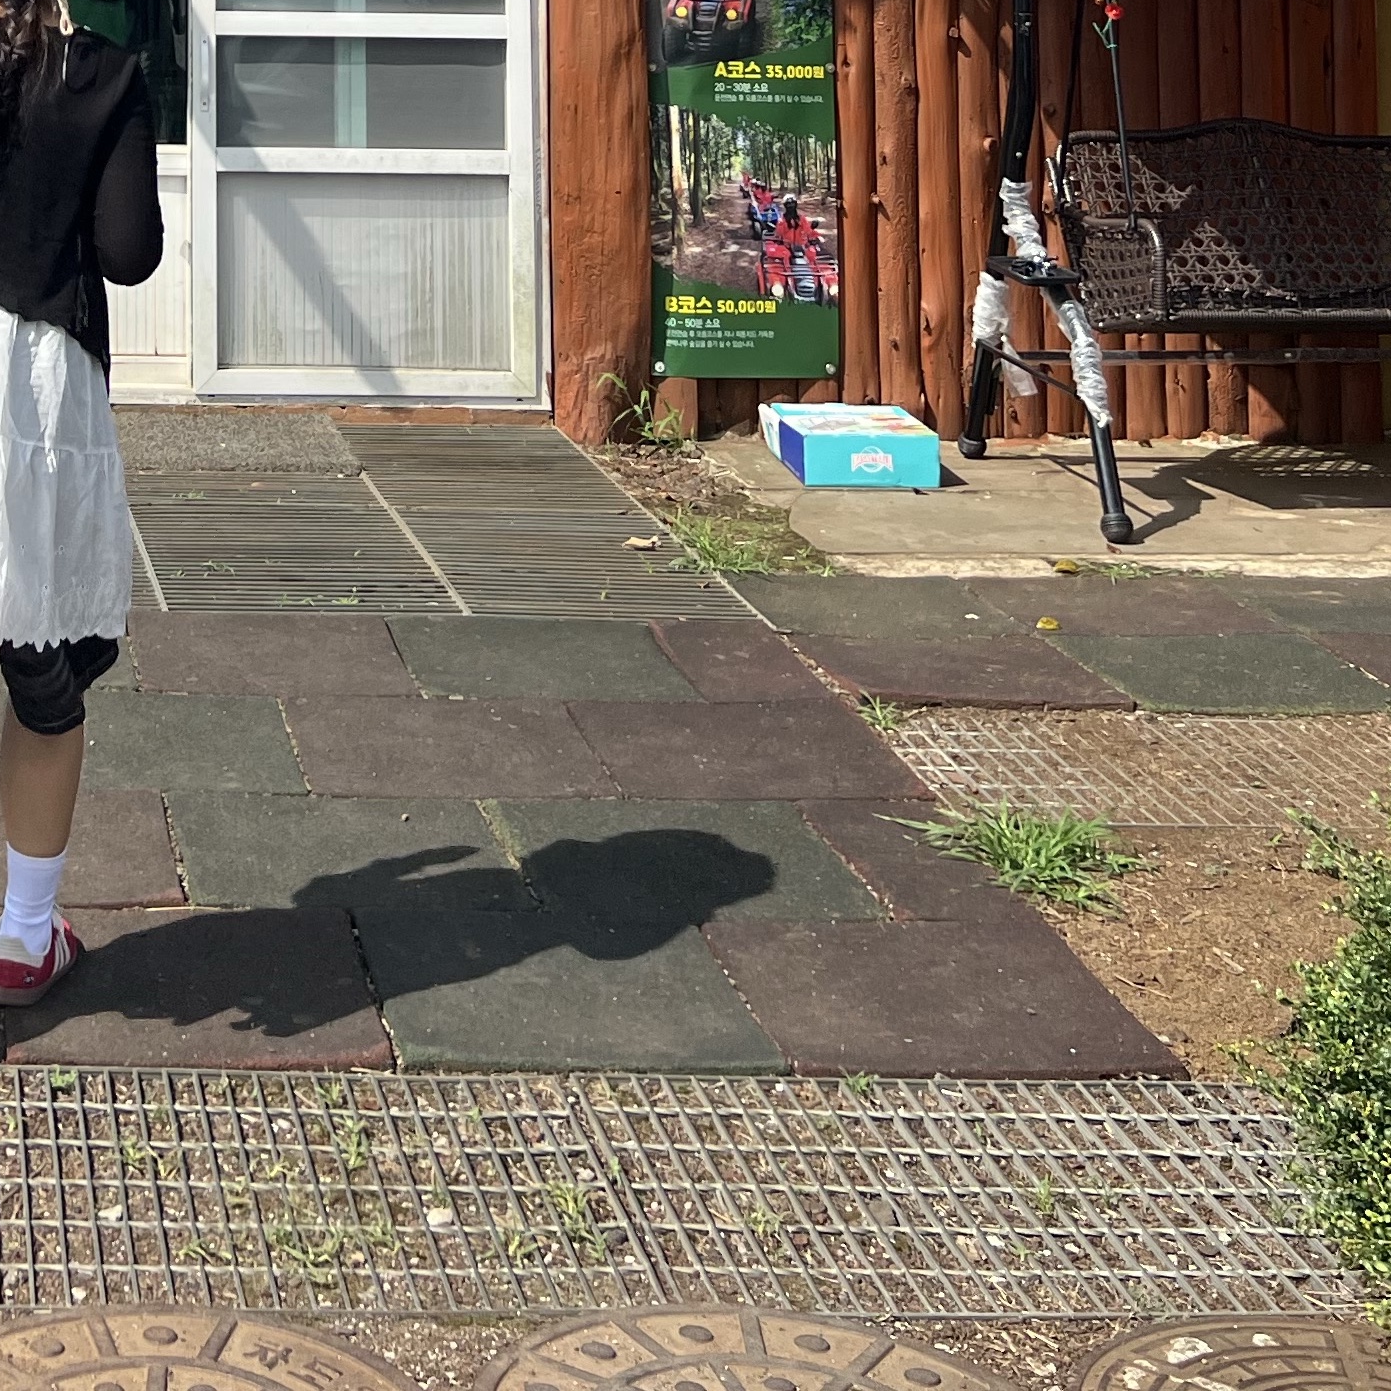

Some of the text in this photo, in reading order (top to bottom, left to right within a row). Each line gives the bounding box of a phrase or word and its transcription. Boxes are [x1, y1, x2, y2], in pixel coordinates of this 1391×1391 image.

[714, 61, 824, 80] A코스 35,000원
[753, 83, 769, 92] 소요
[665, 295, 776, 315] B코스 50,000원
[705, 318, 720, 328] 소요
